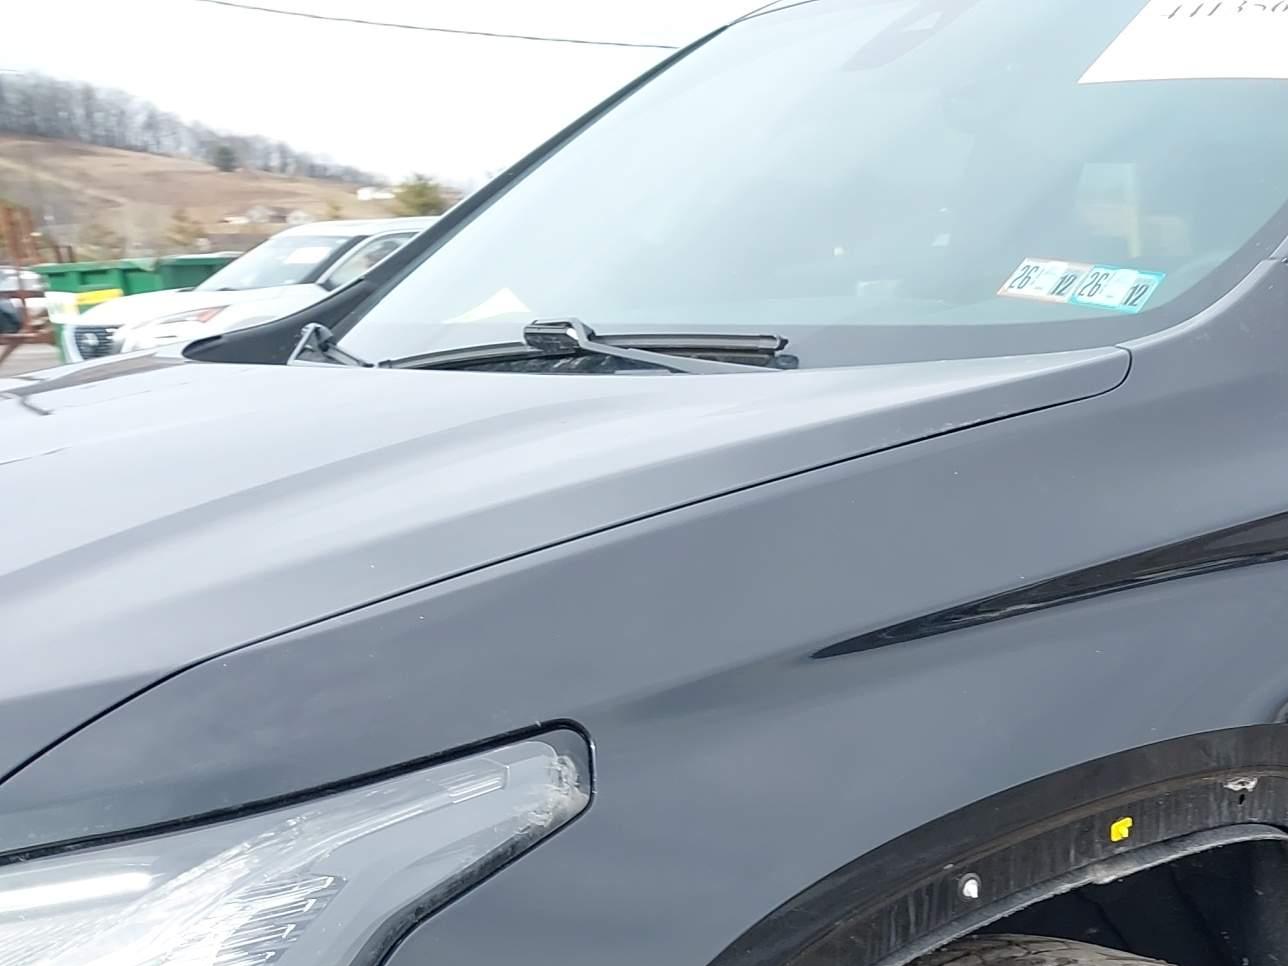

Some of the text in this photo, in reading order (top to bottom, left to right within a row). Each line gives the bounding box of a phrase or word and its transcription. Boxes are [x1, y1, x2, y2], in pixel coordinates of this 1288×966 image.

[1009, 264, 1078, 297] 26 12
[1079, 271, 1150, 307] 26 12
